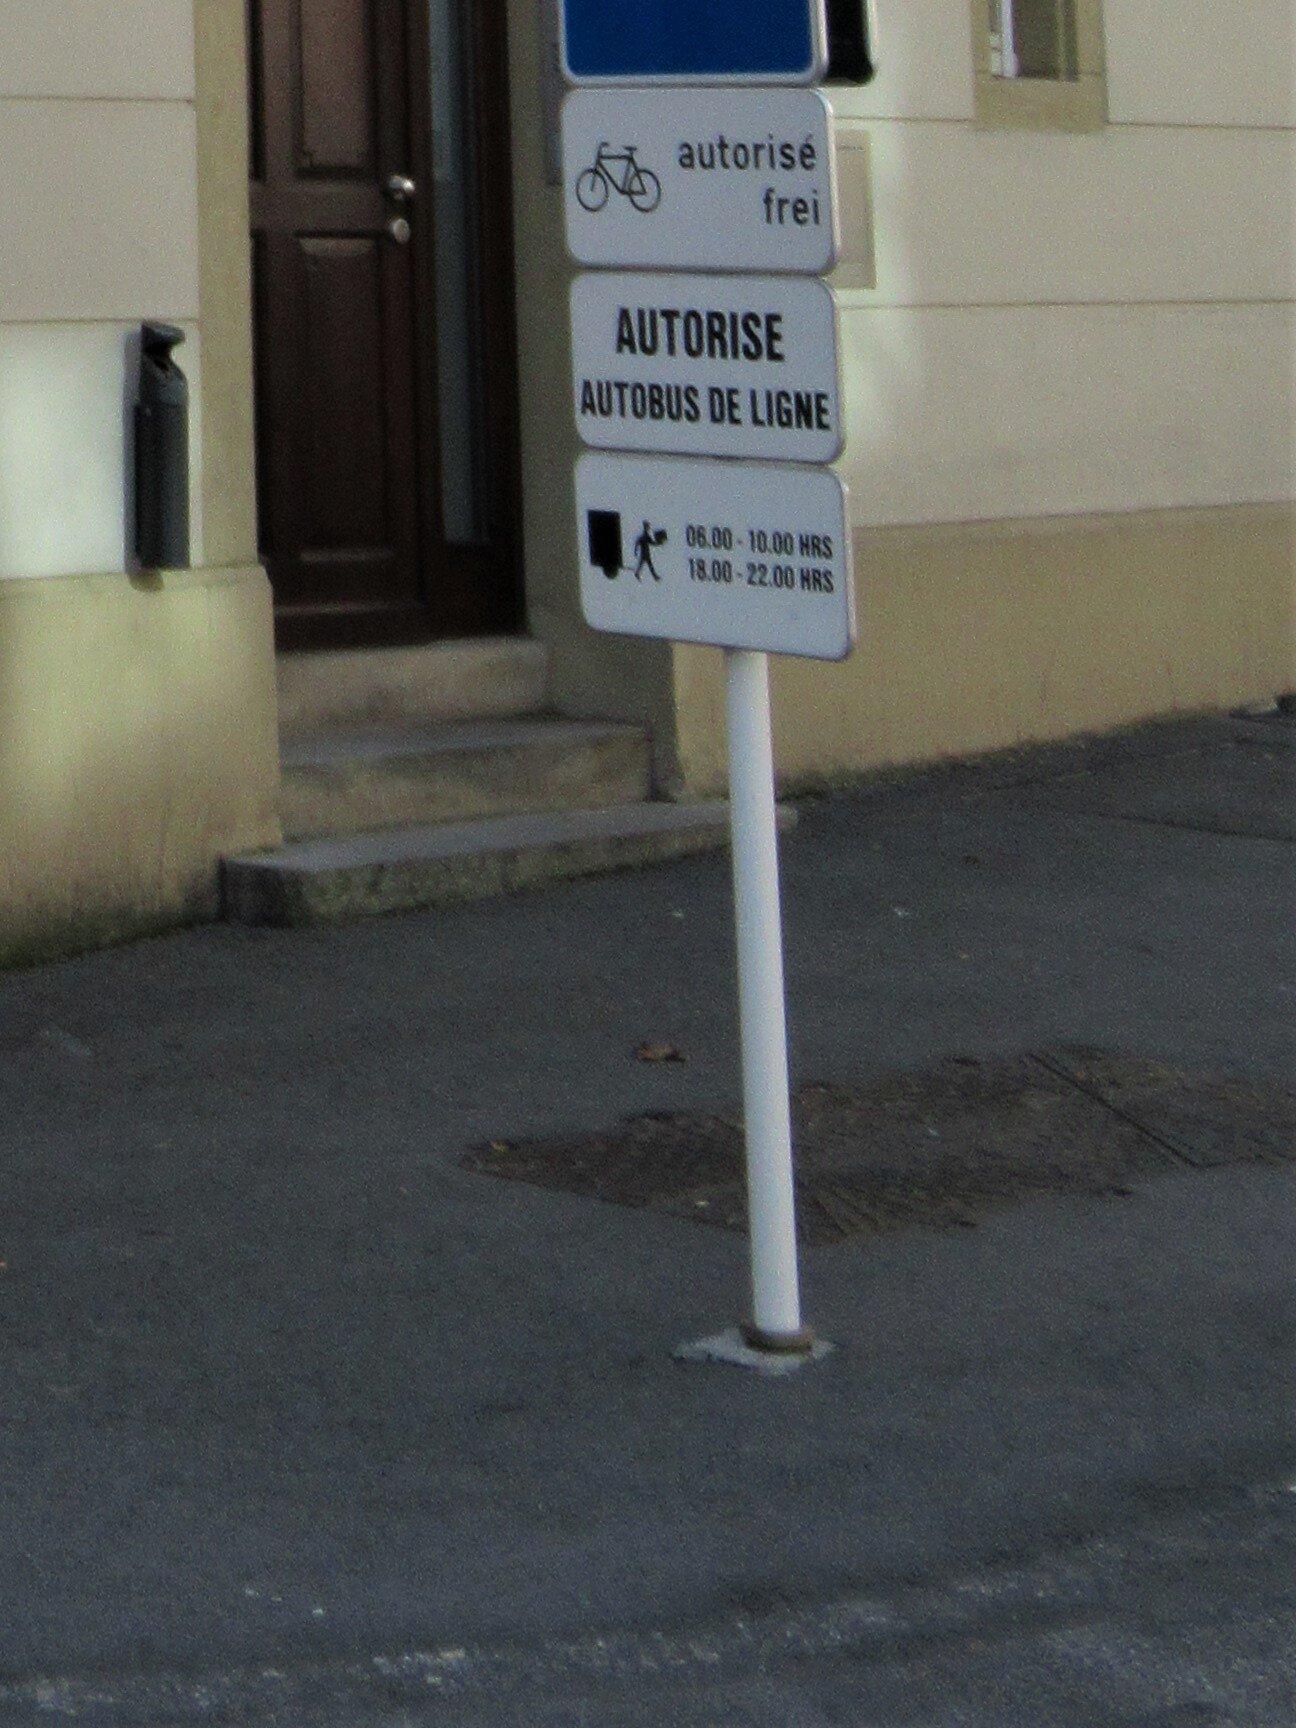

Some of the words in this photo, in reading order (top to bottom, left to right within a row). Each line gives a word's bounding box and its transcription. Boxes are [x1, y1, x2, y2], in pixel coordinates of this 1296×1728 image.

[678, 133, 817, 170] autorisé
[763, 186, 820, 225] frei
[615, 307, 785, 362] AUTORISE
[581, 378, 701, 423] AUTOBUS
[709, 386, 743, 425] DE
[750, 388, 831, 431] LIGNE
[685, 524, 733, 551] 06.00
[748, 528, 795, 556] 10.00
[799, 532, 833, 560] HRS
[688, 557, 733, 584] 18.00
[746, 560, 796, 590] 22.00
[800, 565, 835, 594] HRS
